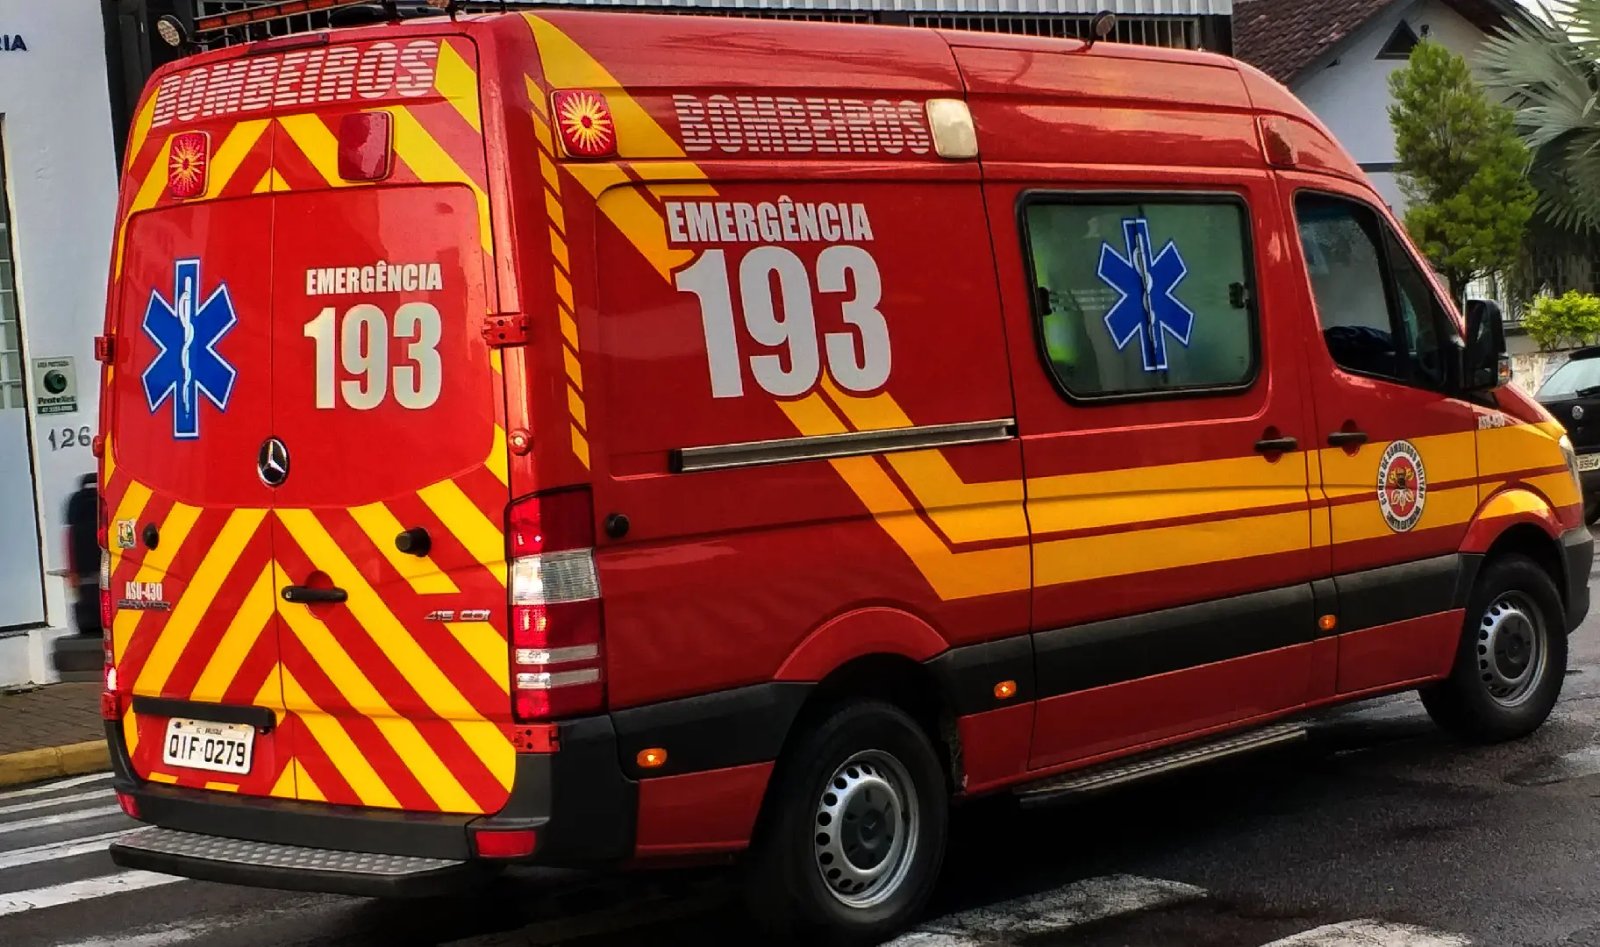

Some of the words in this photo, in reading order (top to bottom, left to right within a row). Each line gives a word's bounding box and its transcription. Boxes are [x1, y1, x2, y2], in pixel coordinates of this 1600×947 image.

[0, 34, 27, 51] IA
[151, 39, 439, 128] BOMBEIROS
[672, 94, 930, 154] BOMBEIROS
[665, 195, 874, 242] EMERGÊNCIA
[306, 260, 443, 295] EMERGÊNCIA
[675, 245, 892, 398] 193
[304, 302, 443, 410] 193
[48, 426, 91, 451] 126
[126, 581, 163, 601] ASU-430
